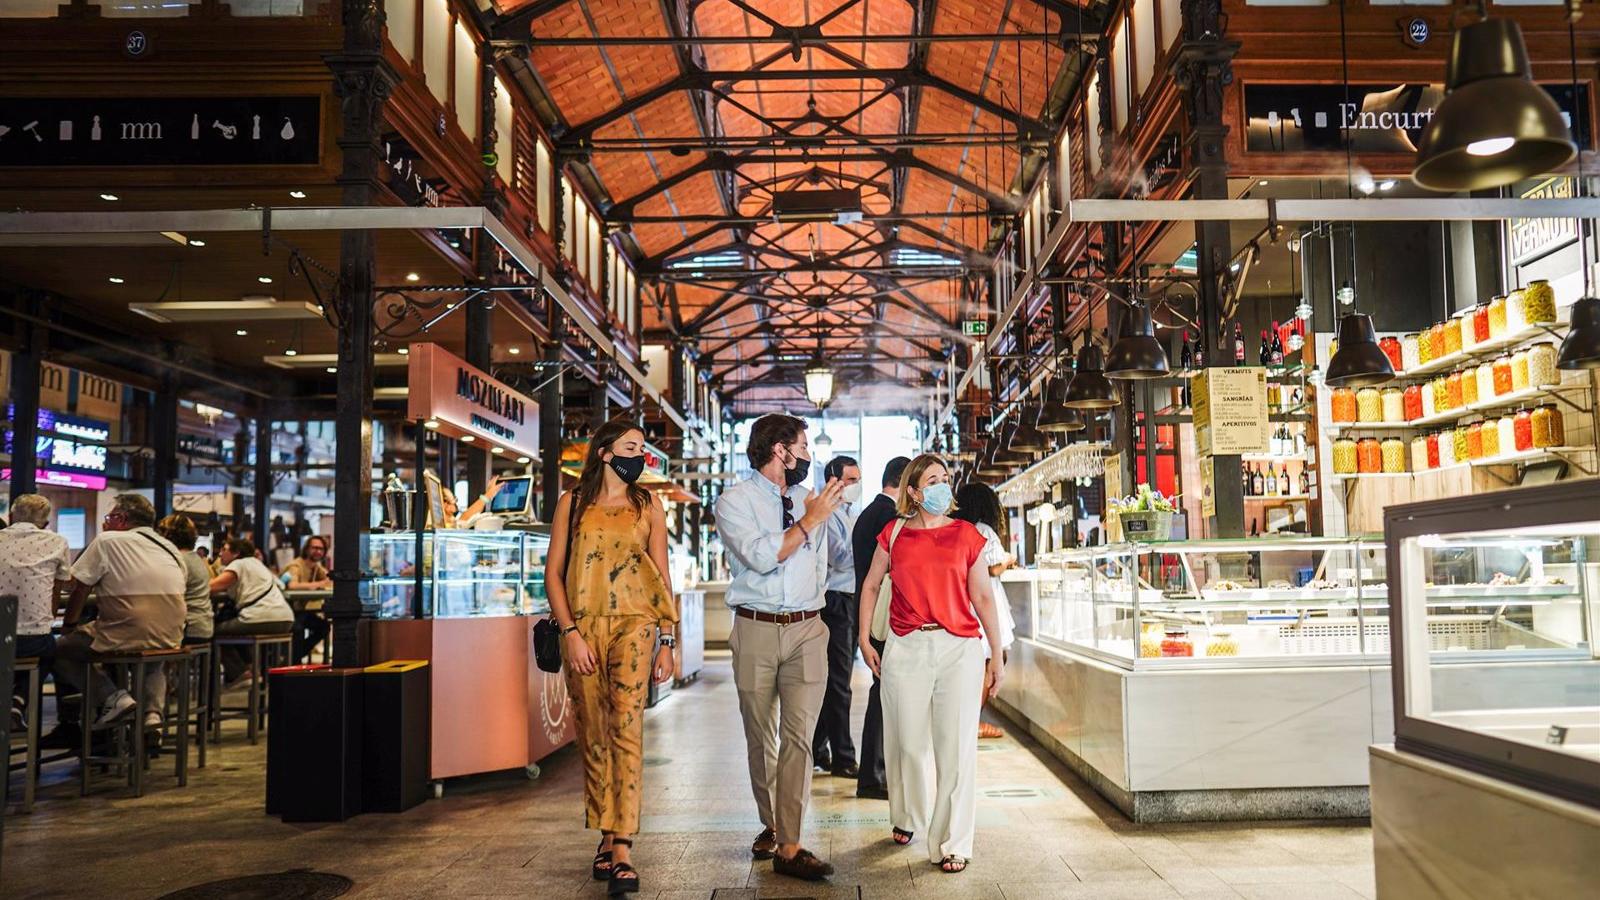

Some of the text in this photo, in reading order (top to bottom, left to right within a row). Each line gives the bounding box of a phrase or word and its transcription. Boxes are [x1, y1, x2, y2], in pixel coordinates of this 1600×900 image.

[1412, 24, 1426, 36] 22
[128, 36, 143, 48] 37
[1339, 103, 1436, 129] Encurt
